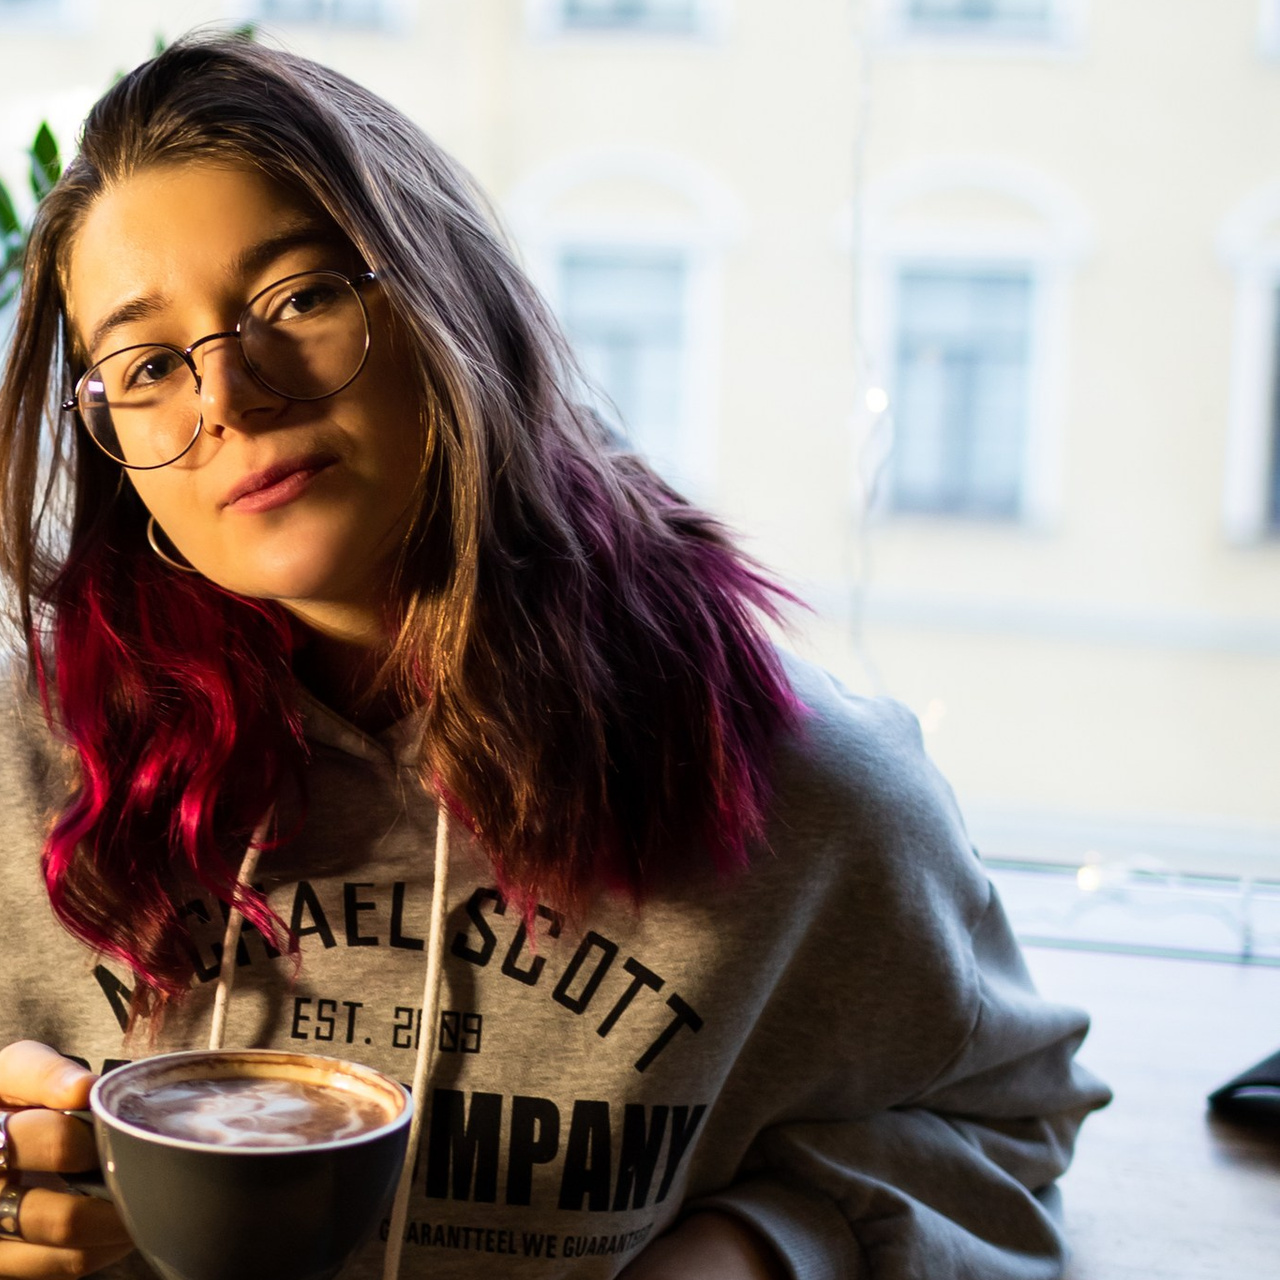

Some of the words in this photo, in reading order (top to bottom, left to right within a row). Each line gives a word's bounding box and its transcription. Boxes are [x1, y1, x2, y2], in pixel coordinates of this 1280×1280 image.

[94, 880, 425, 1033] MCHAEL
[450, 886, 704, 1073] SCOTT
[290, 997, 372, 1045] EST.
[392, 1006, 483, 1054] 209
[412, 1088, 707, 1212] MPANY
[379, 1218, 517, 1255] GARANTTEEL
[522, 1230, 558, 1259] WE
